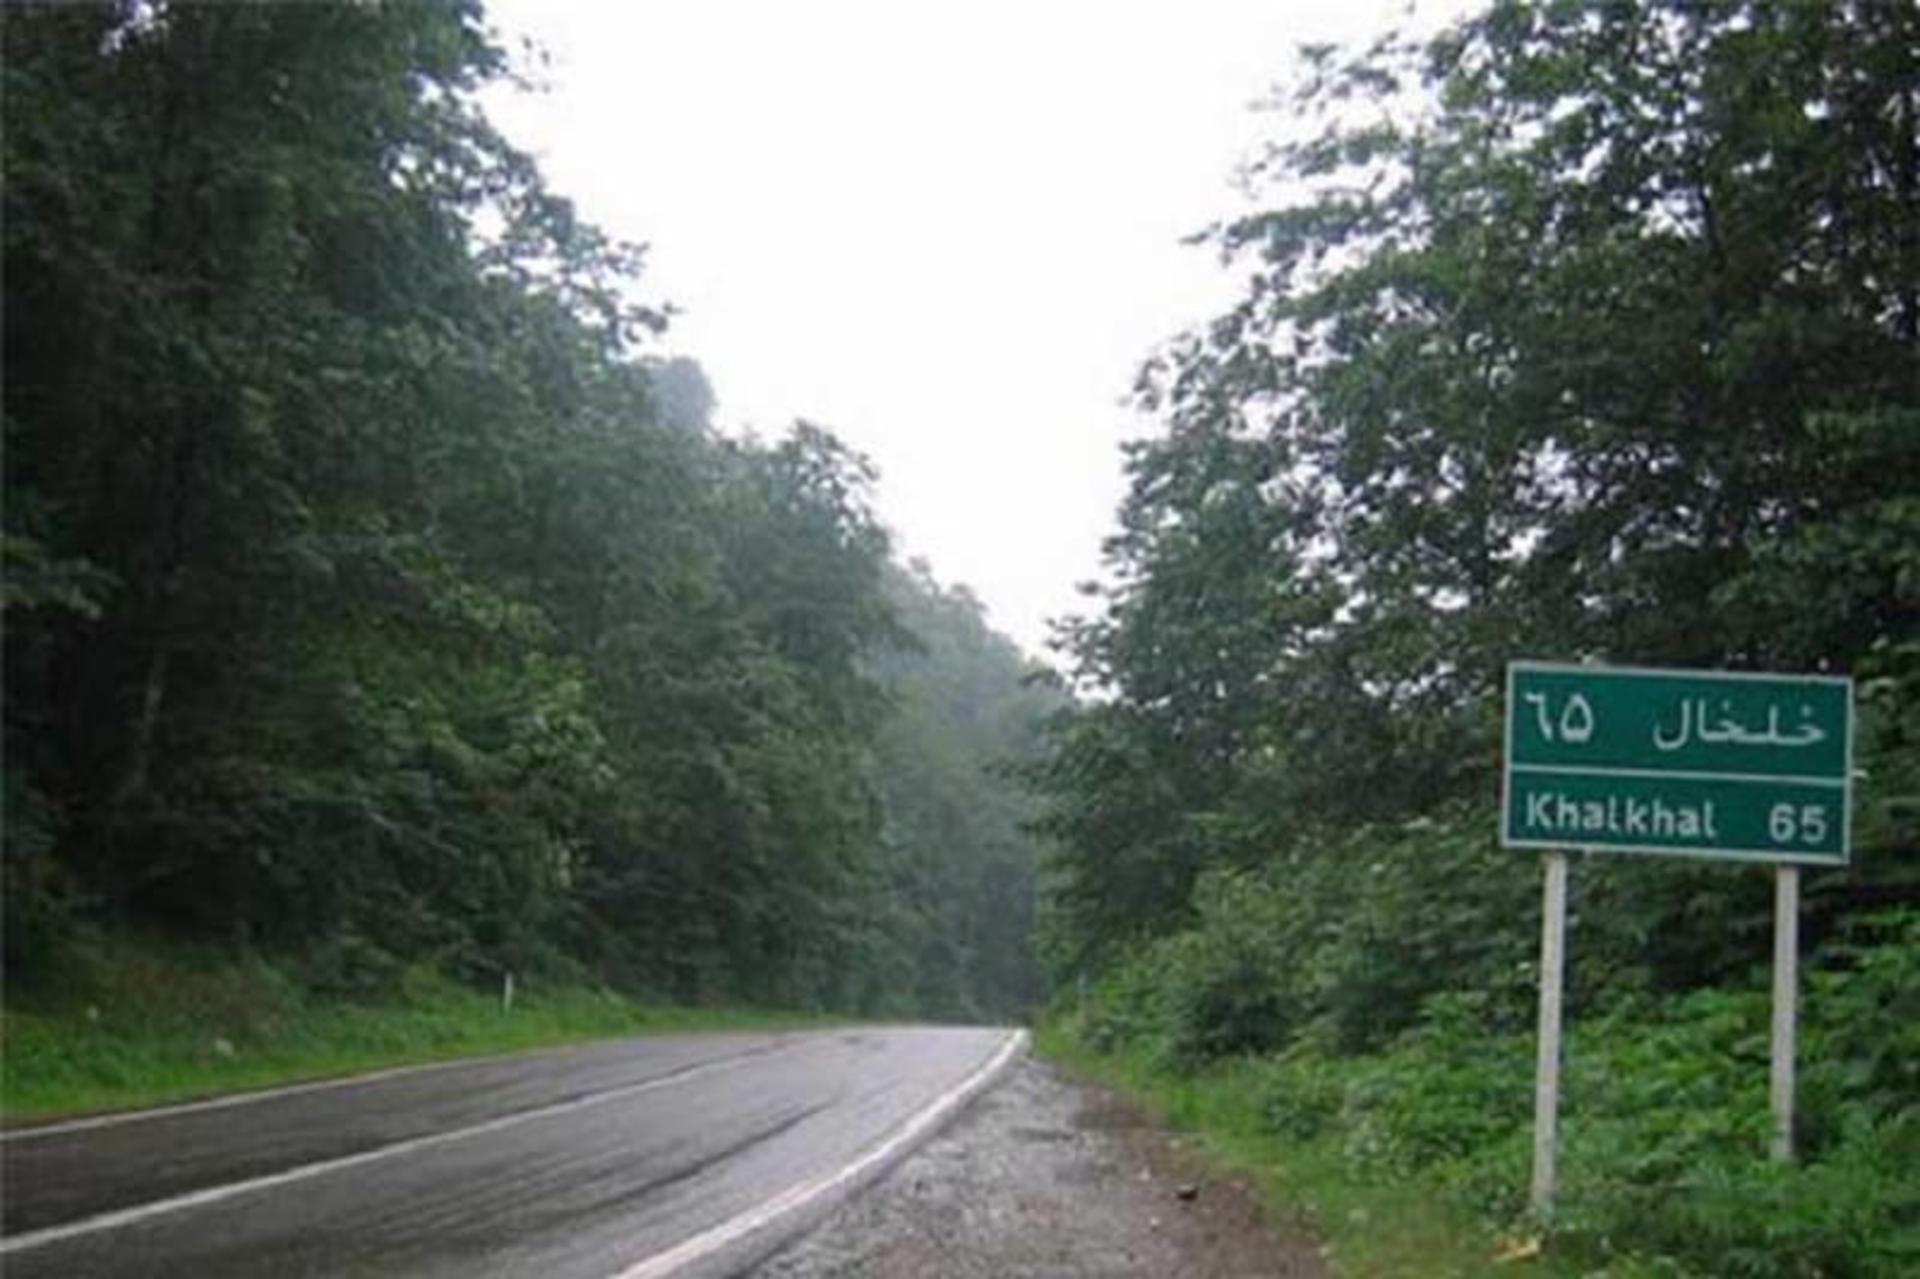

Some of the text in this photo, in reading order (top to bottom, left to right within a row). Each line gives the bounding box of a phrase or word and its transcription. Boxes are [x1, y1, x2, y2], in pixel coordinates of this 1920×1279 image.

[1653, 698, 1826, 750] خلخال
[1525, 791, 1827, 844] Khalkhal 65
